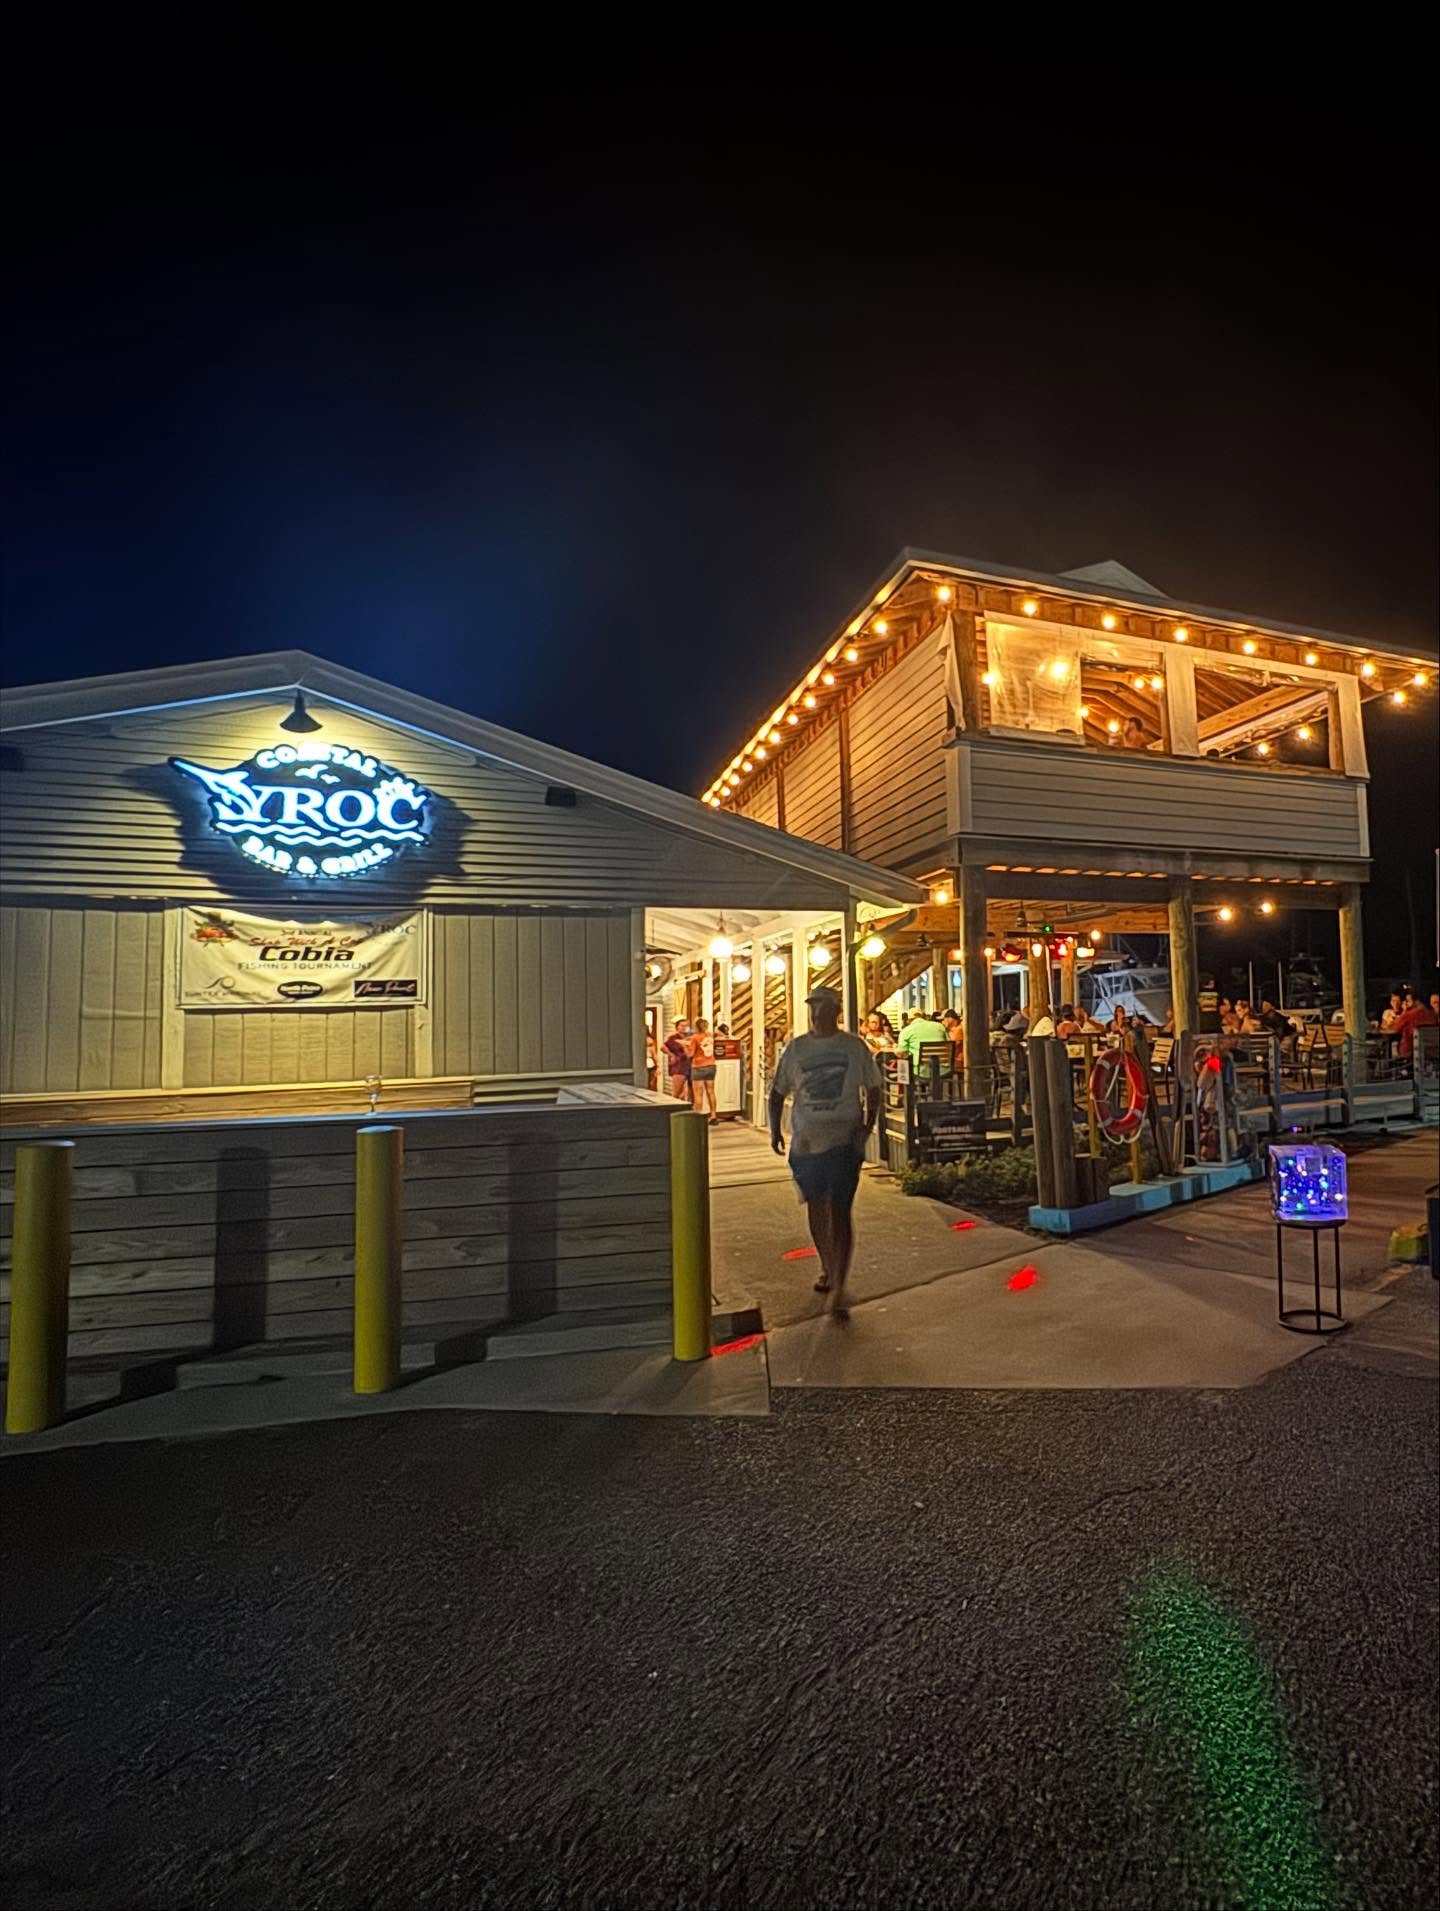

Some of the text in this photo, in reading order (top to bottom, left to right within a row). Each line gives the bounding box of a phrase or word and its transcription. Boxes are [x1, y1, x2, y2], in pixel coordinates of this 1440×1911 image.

[257, 742, 378, 778] COTAL
[208, 772, 427, 832] SYROC
[241, 836, 293, 870] BAR
[321, 843, 394, 874] GRILL
[238, 962, 373, 971] FISHING TOURNAMENT
[259, 946, 355, 962] Cobia
